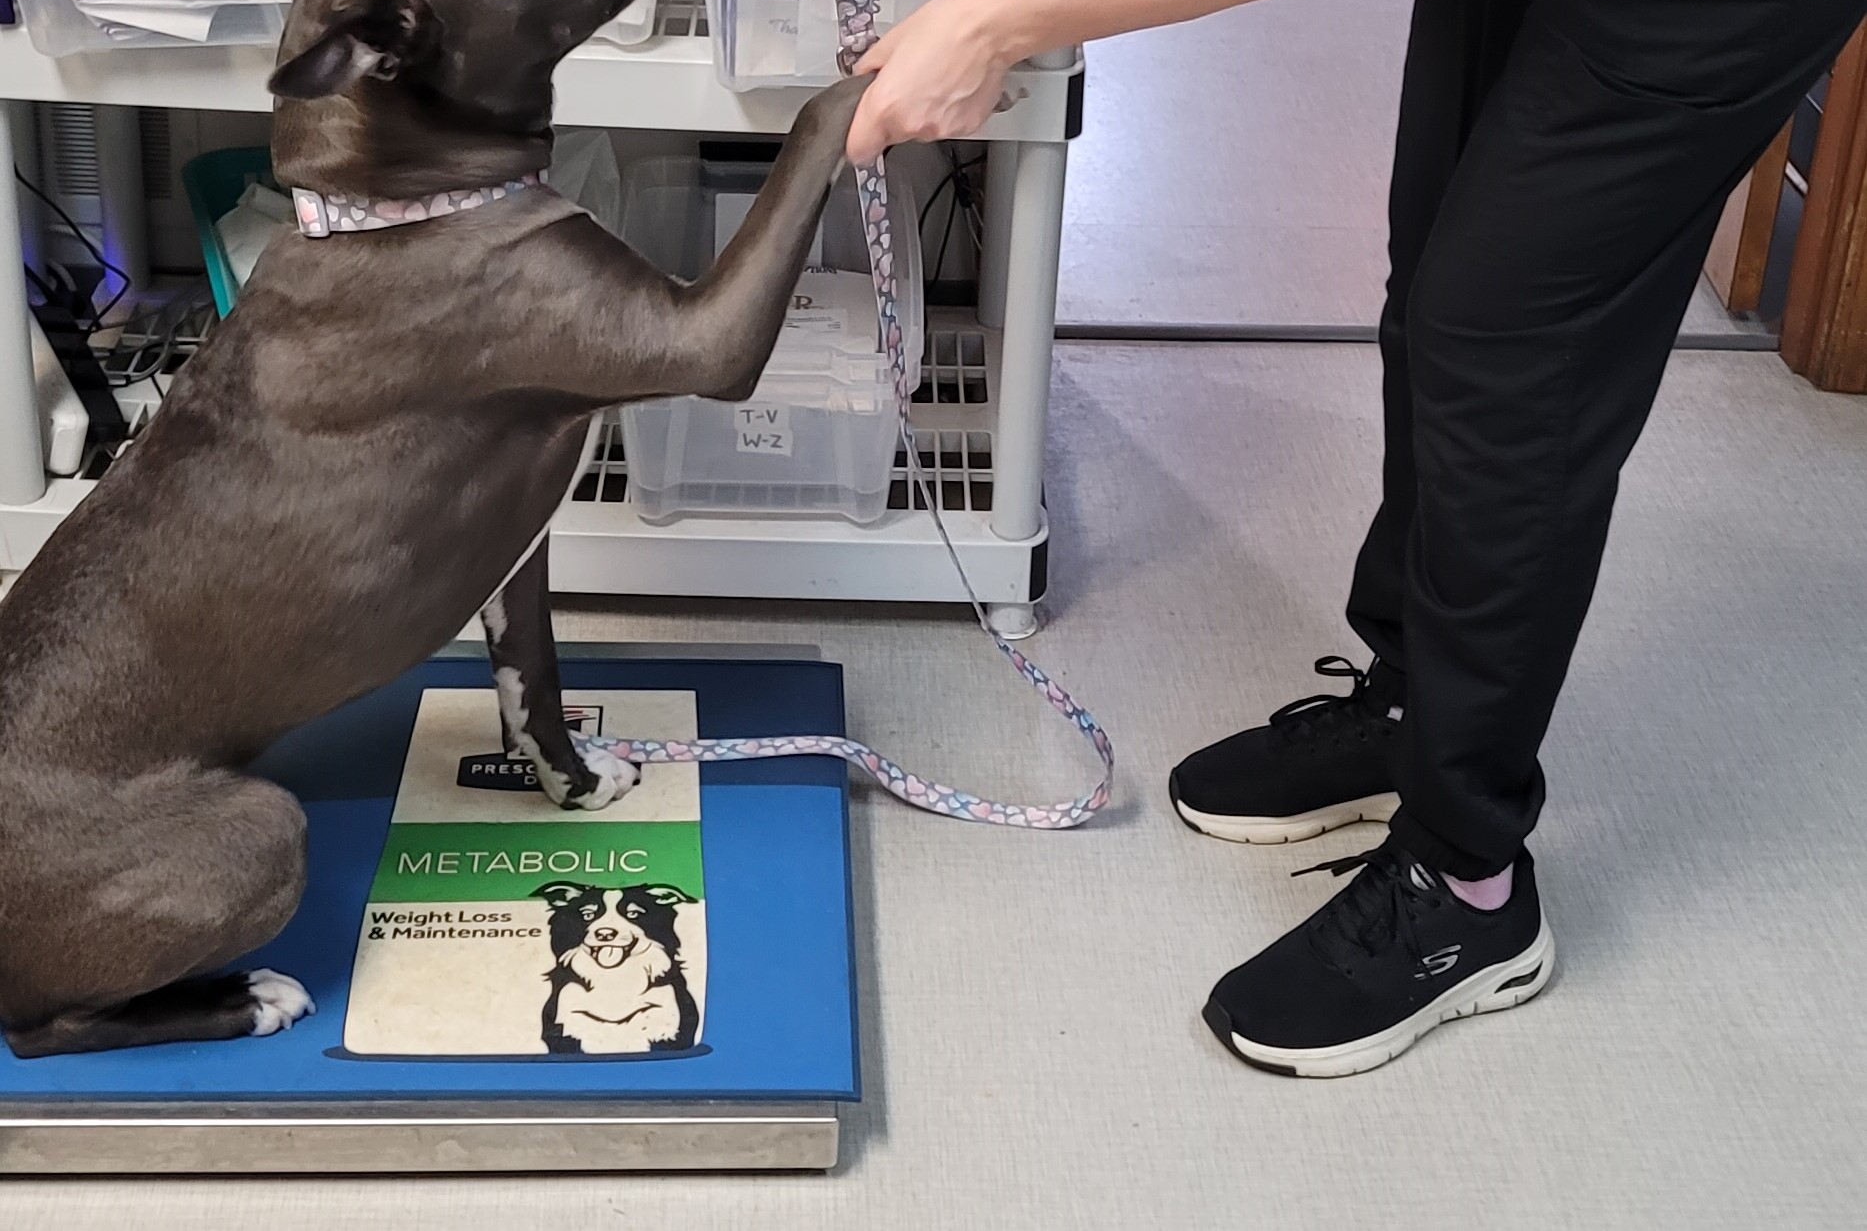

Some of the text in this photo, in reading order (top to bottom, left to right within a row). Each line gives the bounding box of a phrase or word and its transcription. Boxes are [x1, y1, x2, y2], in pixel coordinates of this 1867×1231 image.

[739, 408, 778, 424] T-V
[742, 433, 783, 449] W-Z
[397, 849, 649, 874] METABOLIC
[371, 911, 512, 927] Weight Loss
[368, 927, 542, 940] & Maintenance
